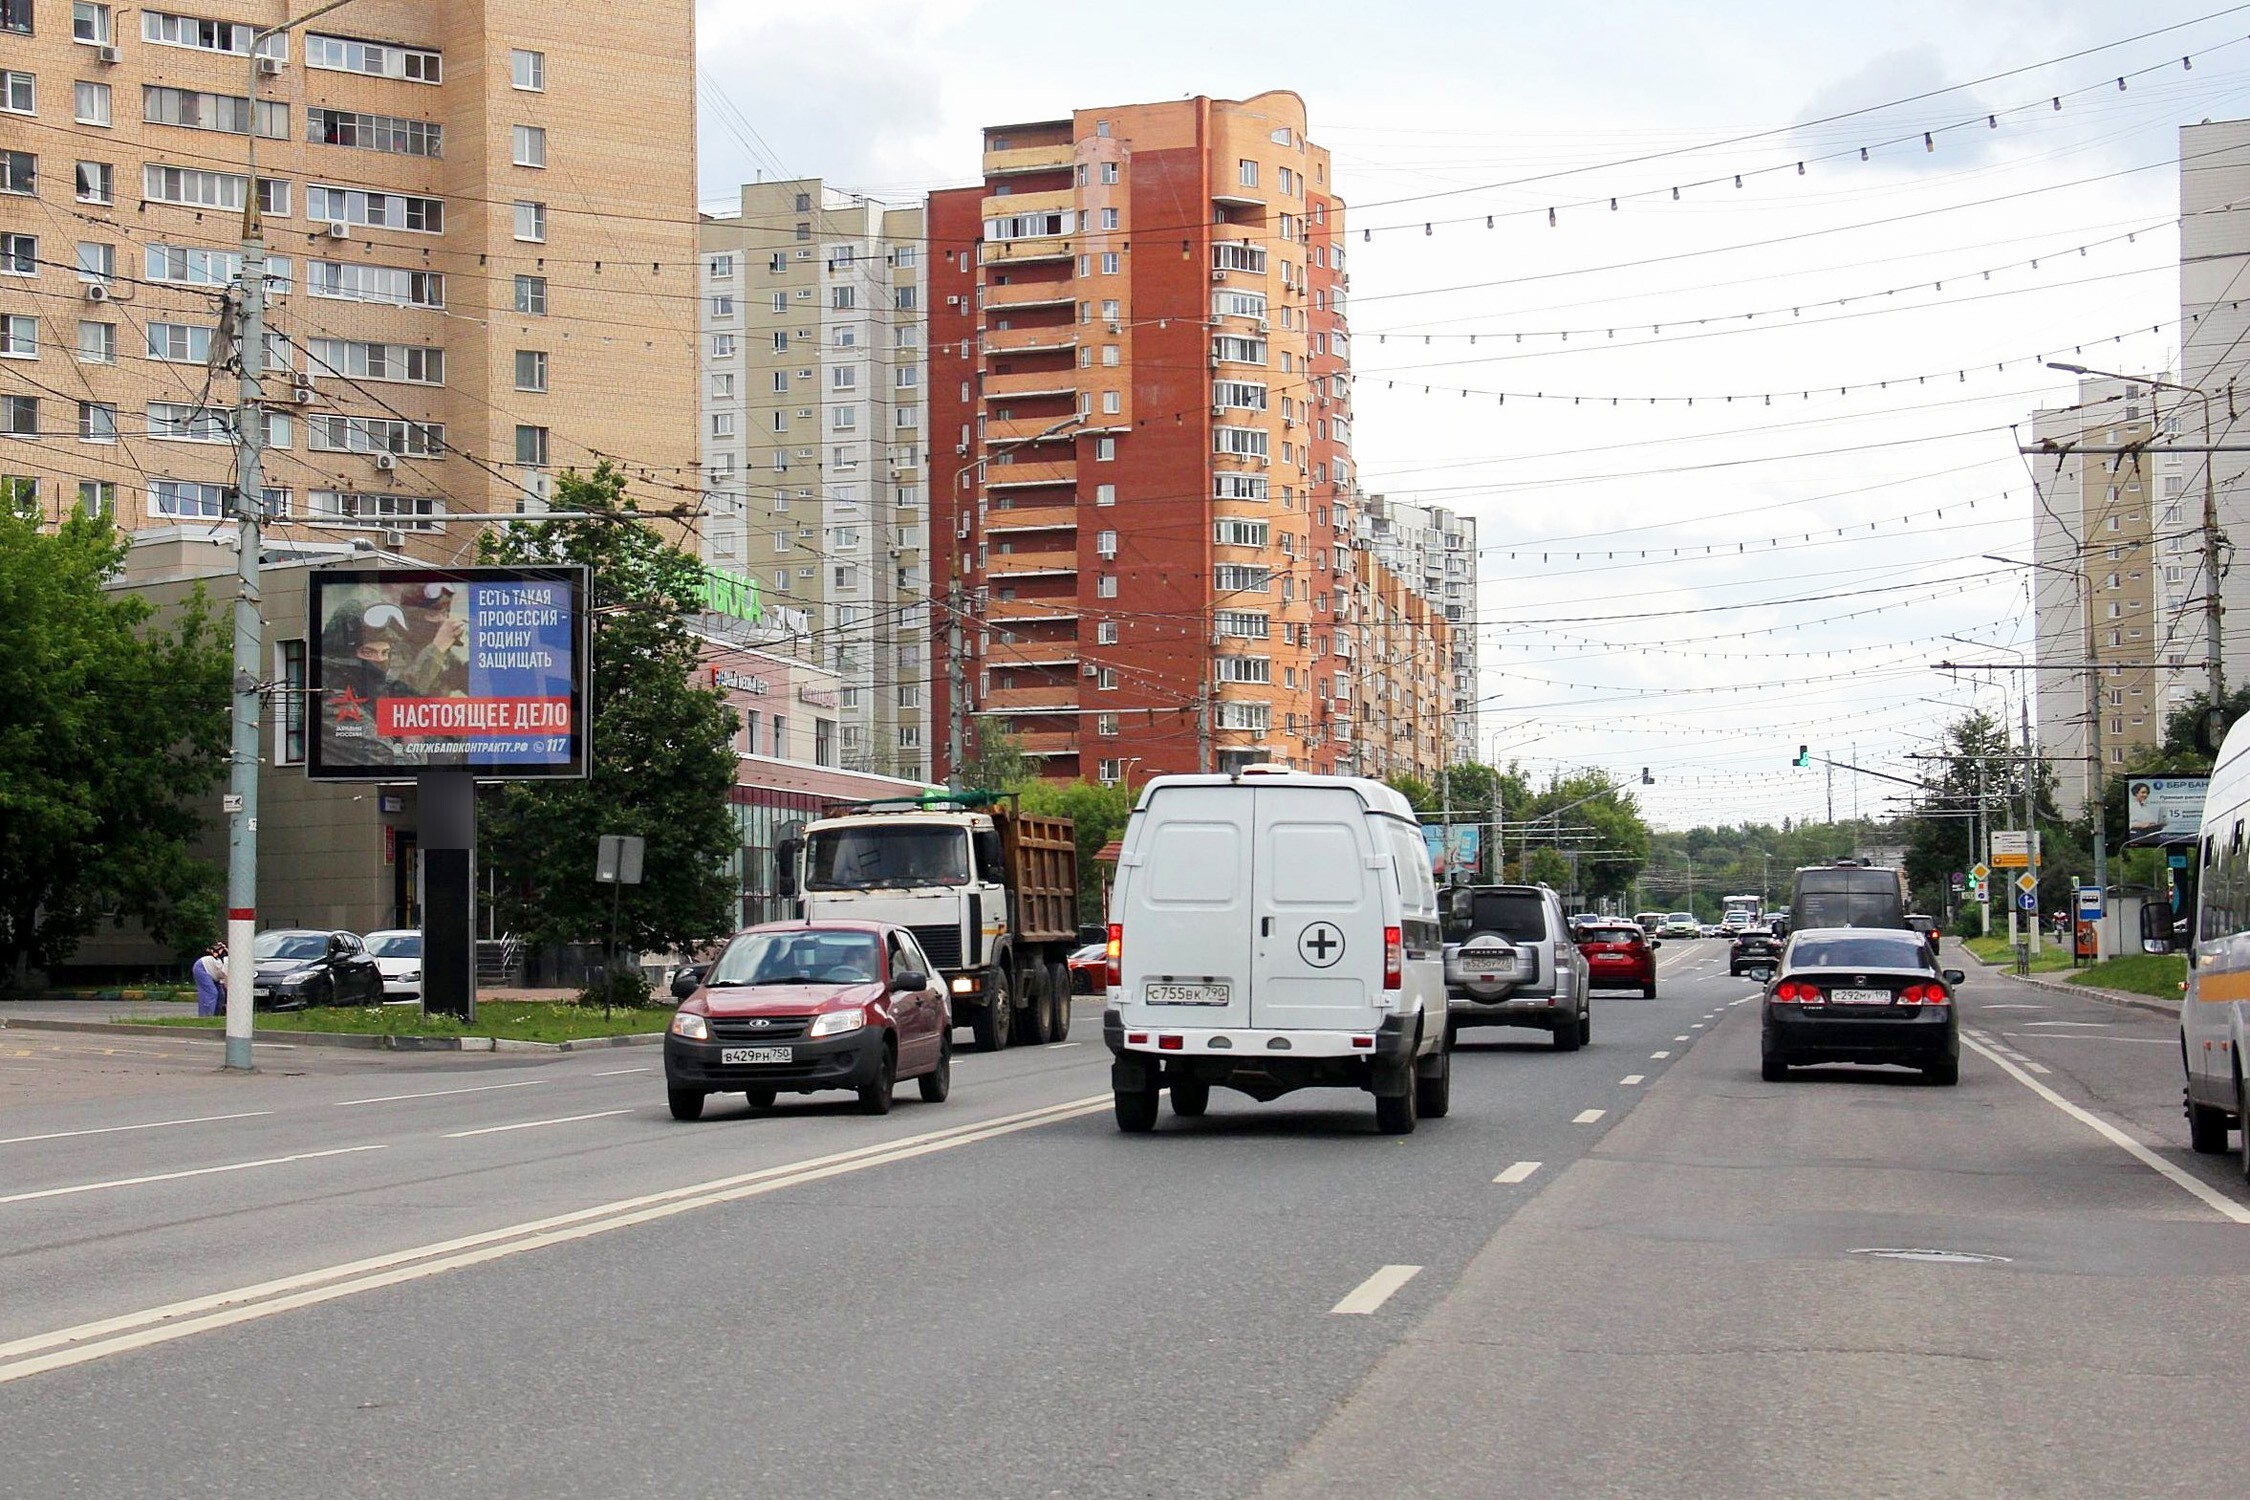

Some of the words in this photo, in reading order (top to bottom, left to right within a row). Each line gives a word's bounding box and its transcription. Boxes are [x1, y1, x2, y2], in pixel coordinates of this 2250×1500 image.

[479, 590, 510, 606] ЕСТЬ
[512, 589, 551, 605] ТАКАЯ
[479, 610, 558, 627] ПРОФЕССИЯ
[479, 631, 531, 649] РОДИНУ
[479, 651, 552, 670] ЗАЩИЩАТЬ
[393, 703, 510, 729] НАСТОЯЩЕЕ
[514, 702, 568, 729] ДЕЛО
[406, 741, 528, 754] СЛУЖБАПОКОНТРАКТУ.РФ
[547, 738, 567, 751] 117
[2166, 781, 2187, 789] ББР
[2169, 809, 2180, 818] 15
